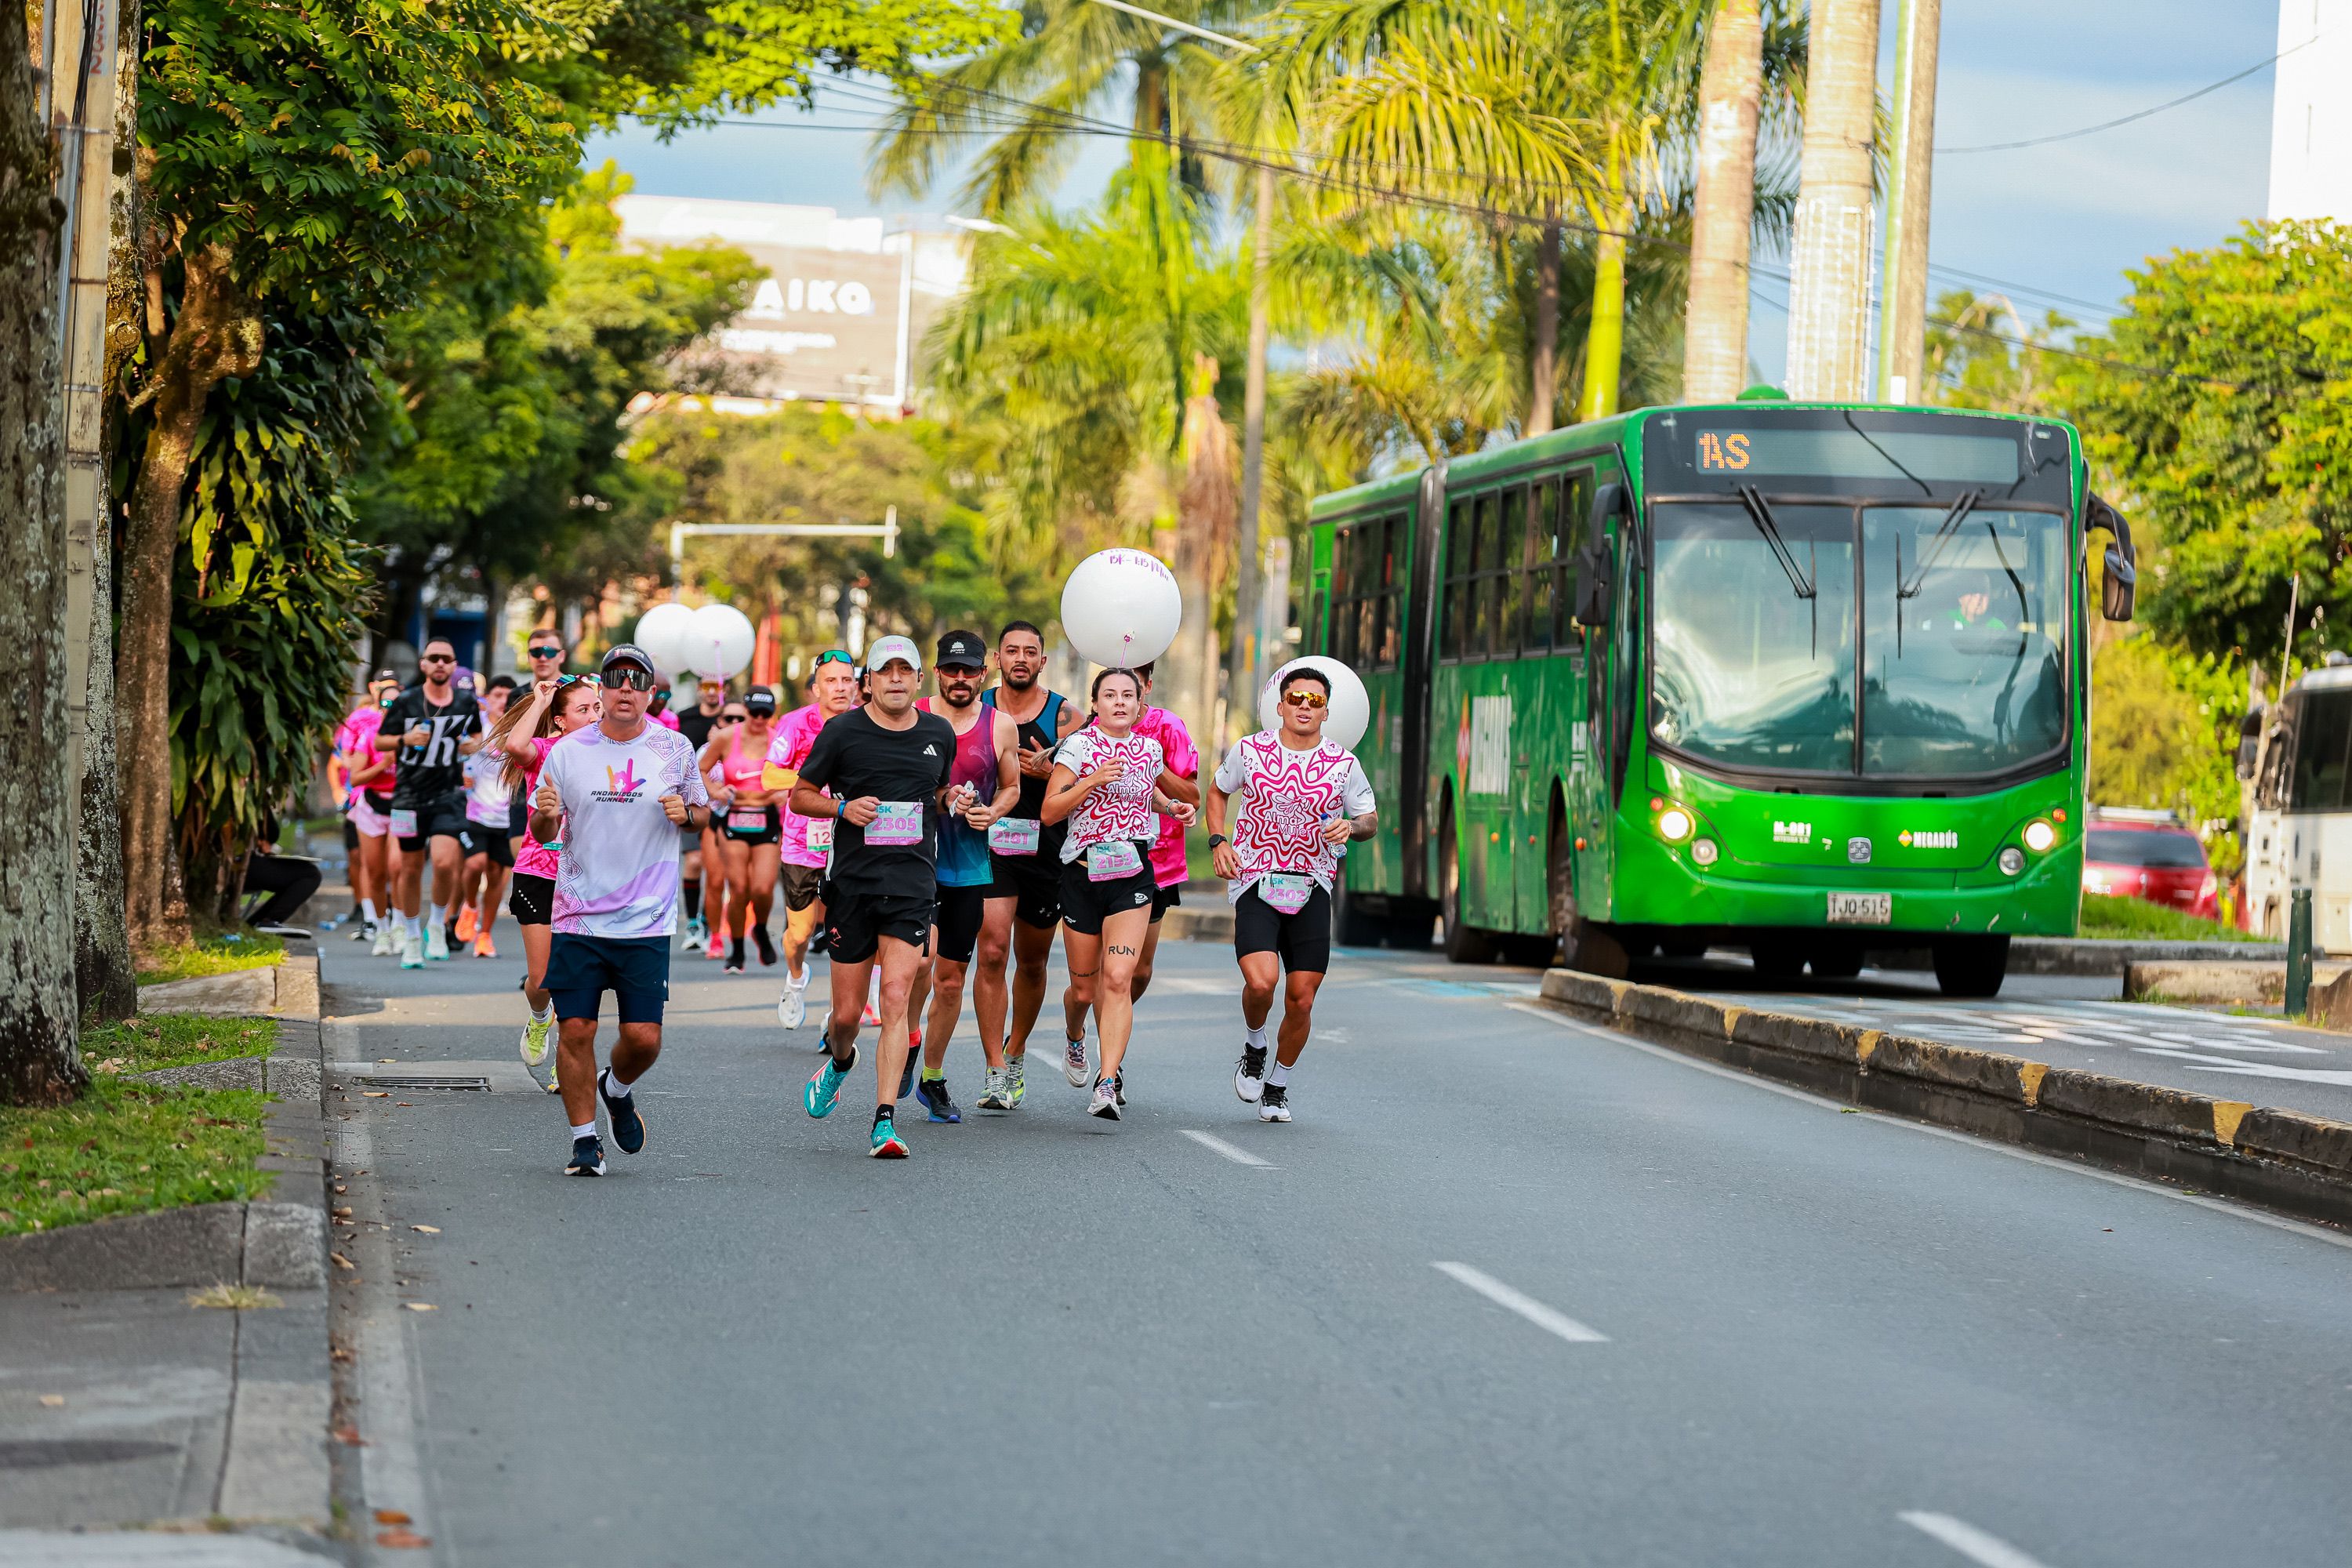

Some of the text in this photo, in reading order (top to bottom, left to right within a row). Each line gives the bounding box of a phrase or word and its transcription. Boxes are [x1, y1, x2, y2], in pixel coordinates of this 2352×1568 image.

[1107, 784, 1137, 794] Alma
[872, 817, 916, 831] 2305
[996, 820, 1010, 829] 5K
[1264, 811, 1299, 826] Alma
[993, 830, 1029, 845] 2181
[1277, 822, 1311, 840] Mujer
[1095, 852, 1134, 869] 2153
[1266, 887, 1306, 902] 2302
[1108, 946, 1135, 957] RUN
